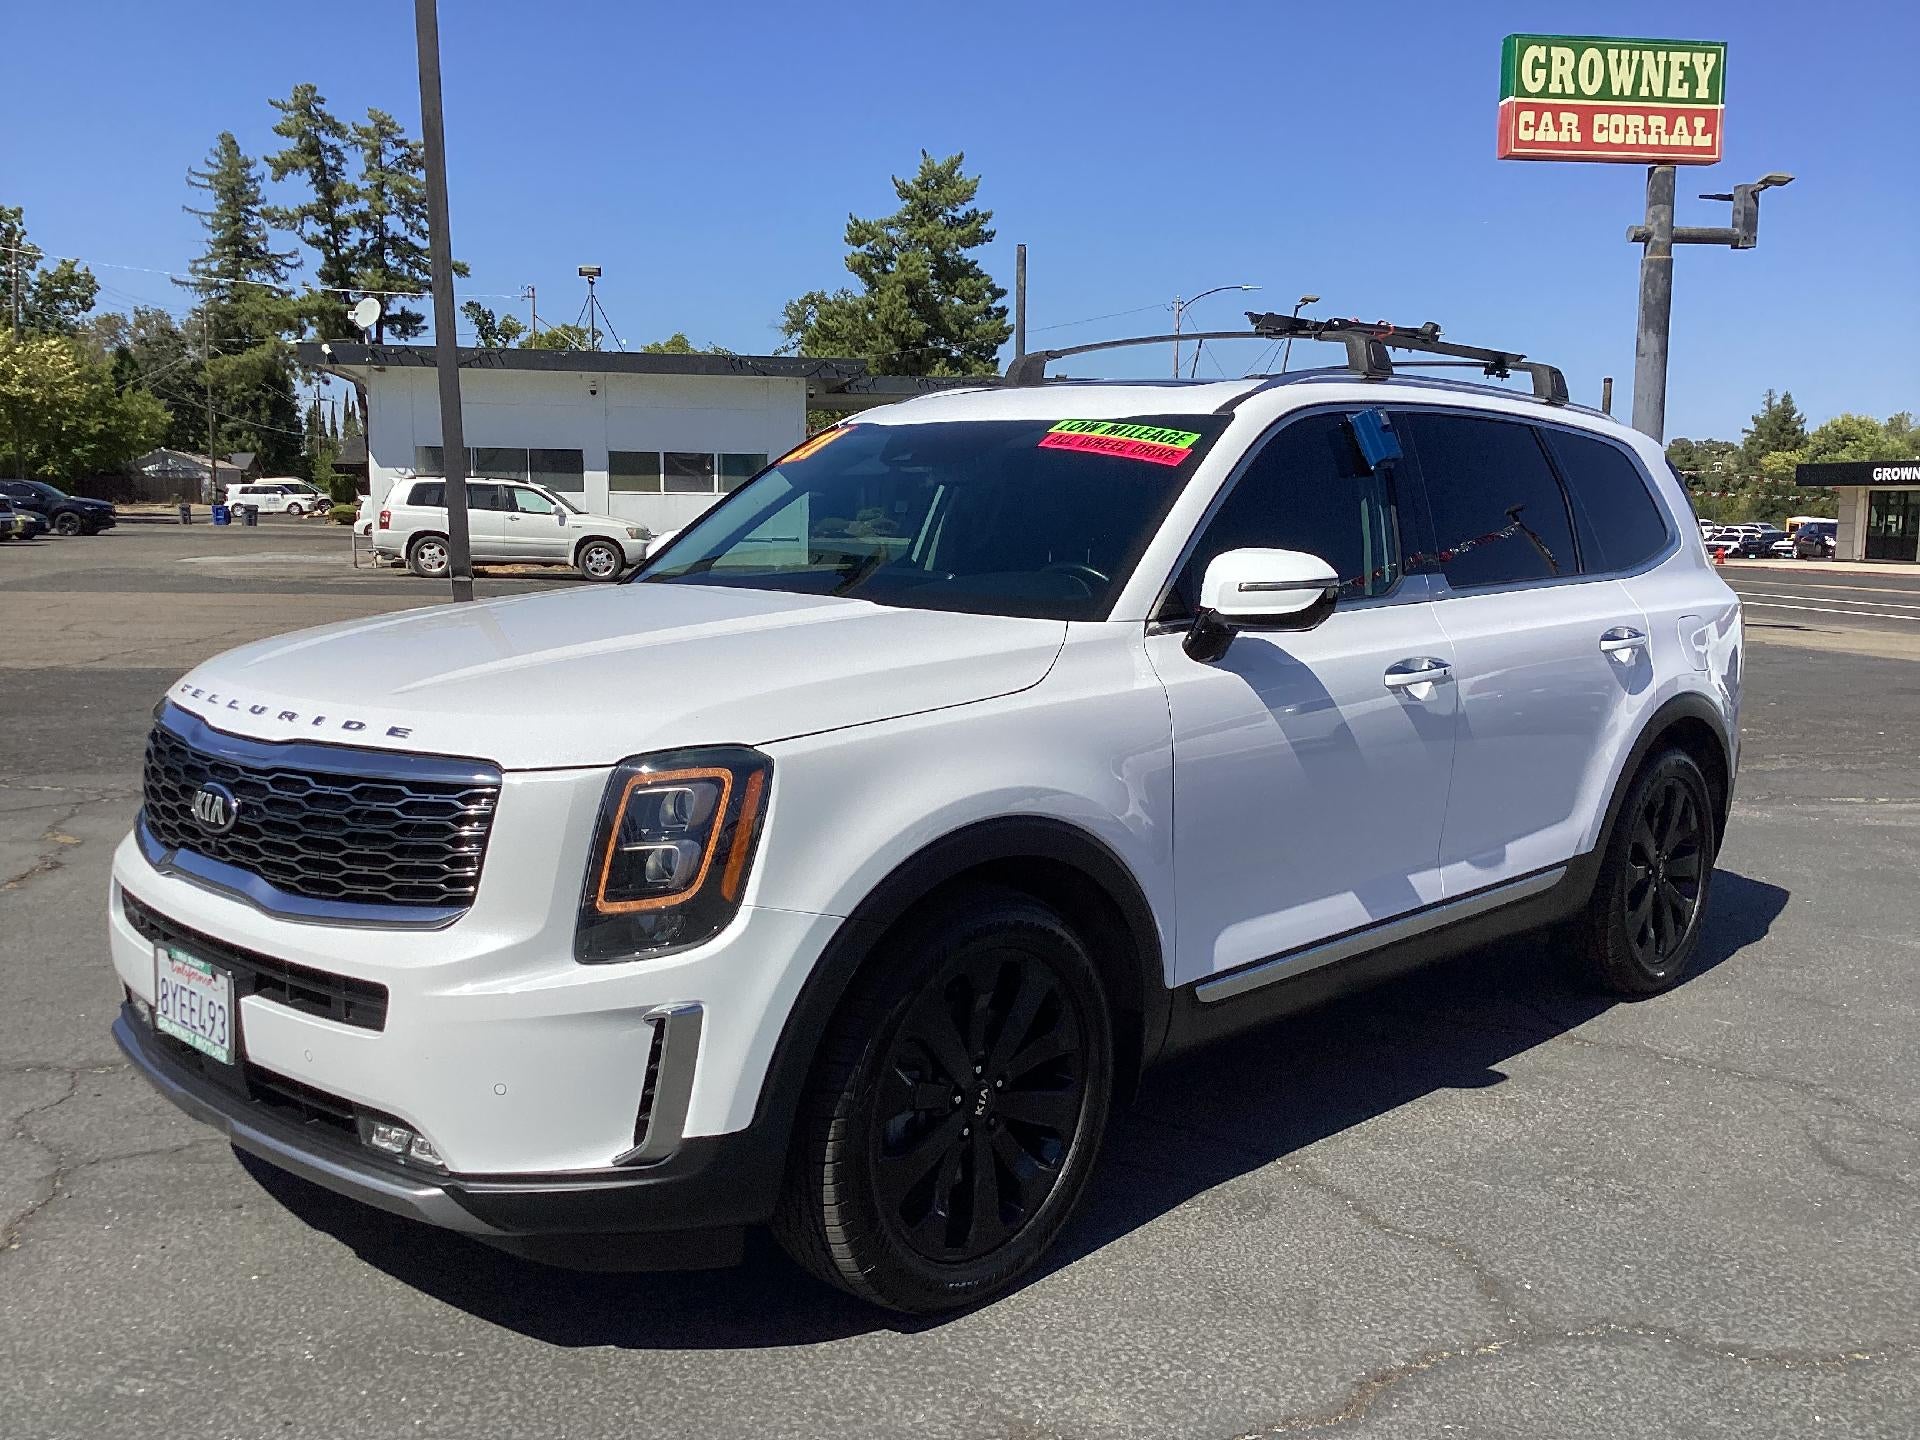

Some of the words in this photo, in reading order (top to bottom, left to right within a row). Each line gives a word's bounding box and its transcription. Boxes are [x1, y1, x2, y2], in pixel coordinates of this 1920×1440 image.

[1521, 45, 1716, 98] GROWNEY
[1518, 111, 1581, 142] CAR
[1592, 113, 1712, 146] CORRAL
[1055, 421, 1107, 433] LOW
[1099, 424, 1193, 445] MILEAGE
[1873, 467, 1920, 480] GROWN
[181, 683, 413, 739] TELLURIDE
[195, 790, 225, 825] KIA
[161, 977, 226, 1045] 8YEE493
[975, 1088, 988, 1115] KIA
